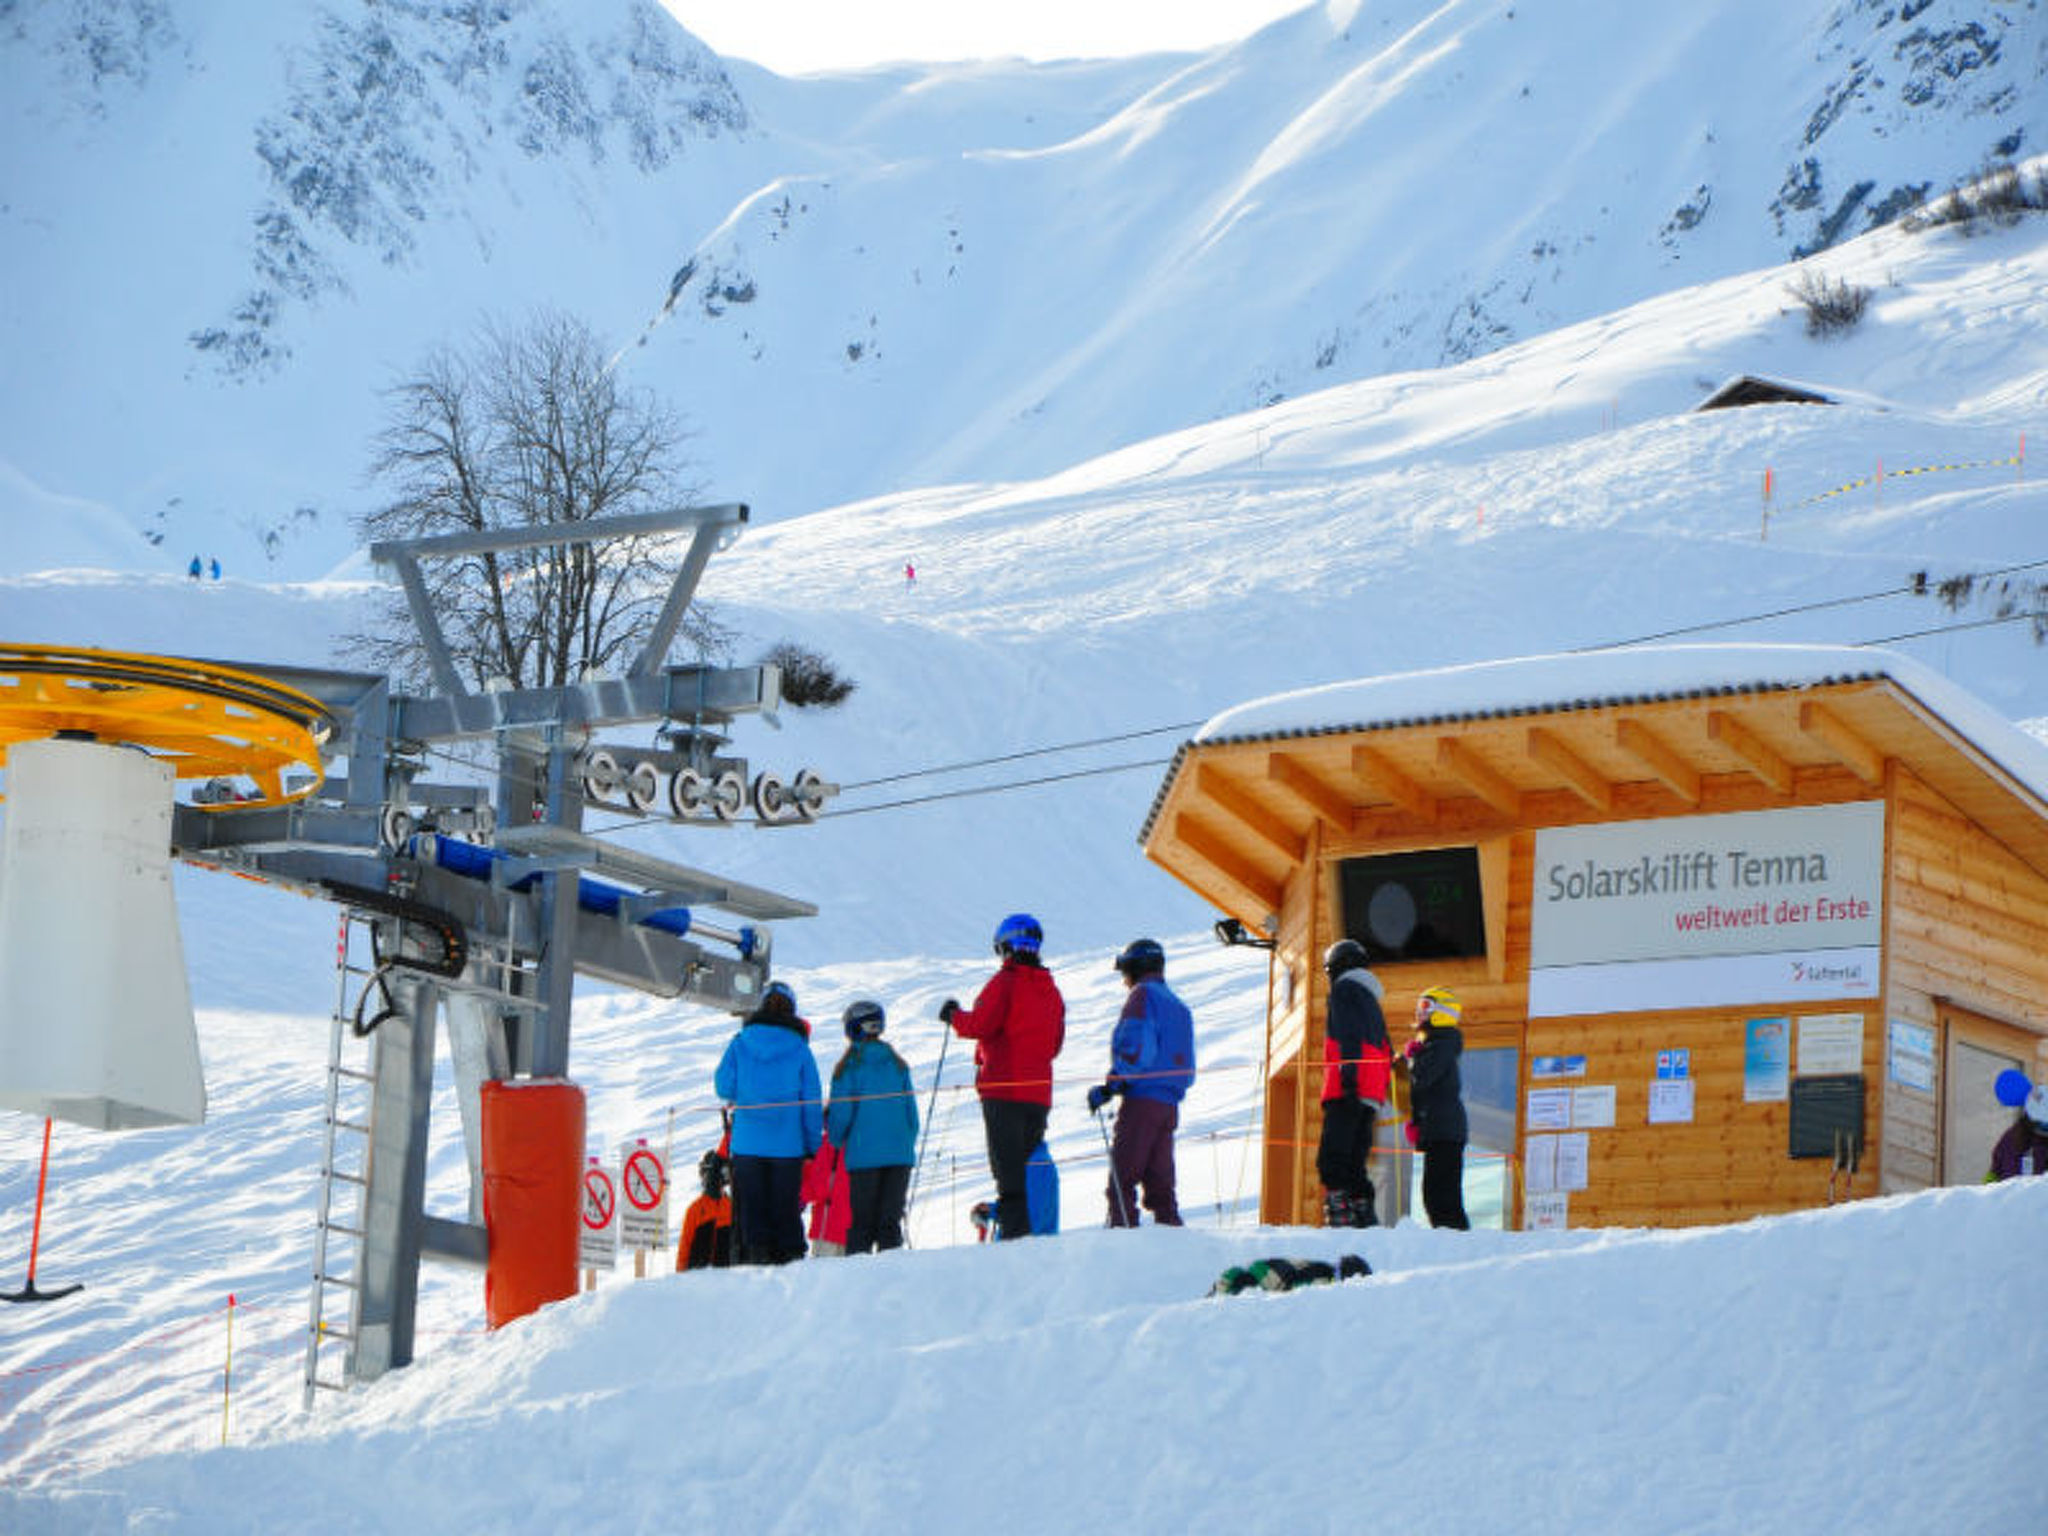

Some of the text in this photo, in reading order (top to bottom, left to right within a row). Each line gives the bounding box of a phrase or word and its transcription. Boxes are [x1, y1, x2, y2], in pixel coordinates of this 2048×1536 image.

[1548, 851, 1827, 901] Solarskilift Tenna
[1676, 897, 1870, 931] weltweit der Erste
